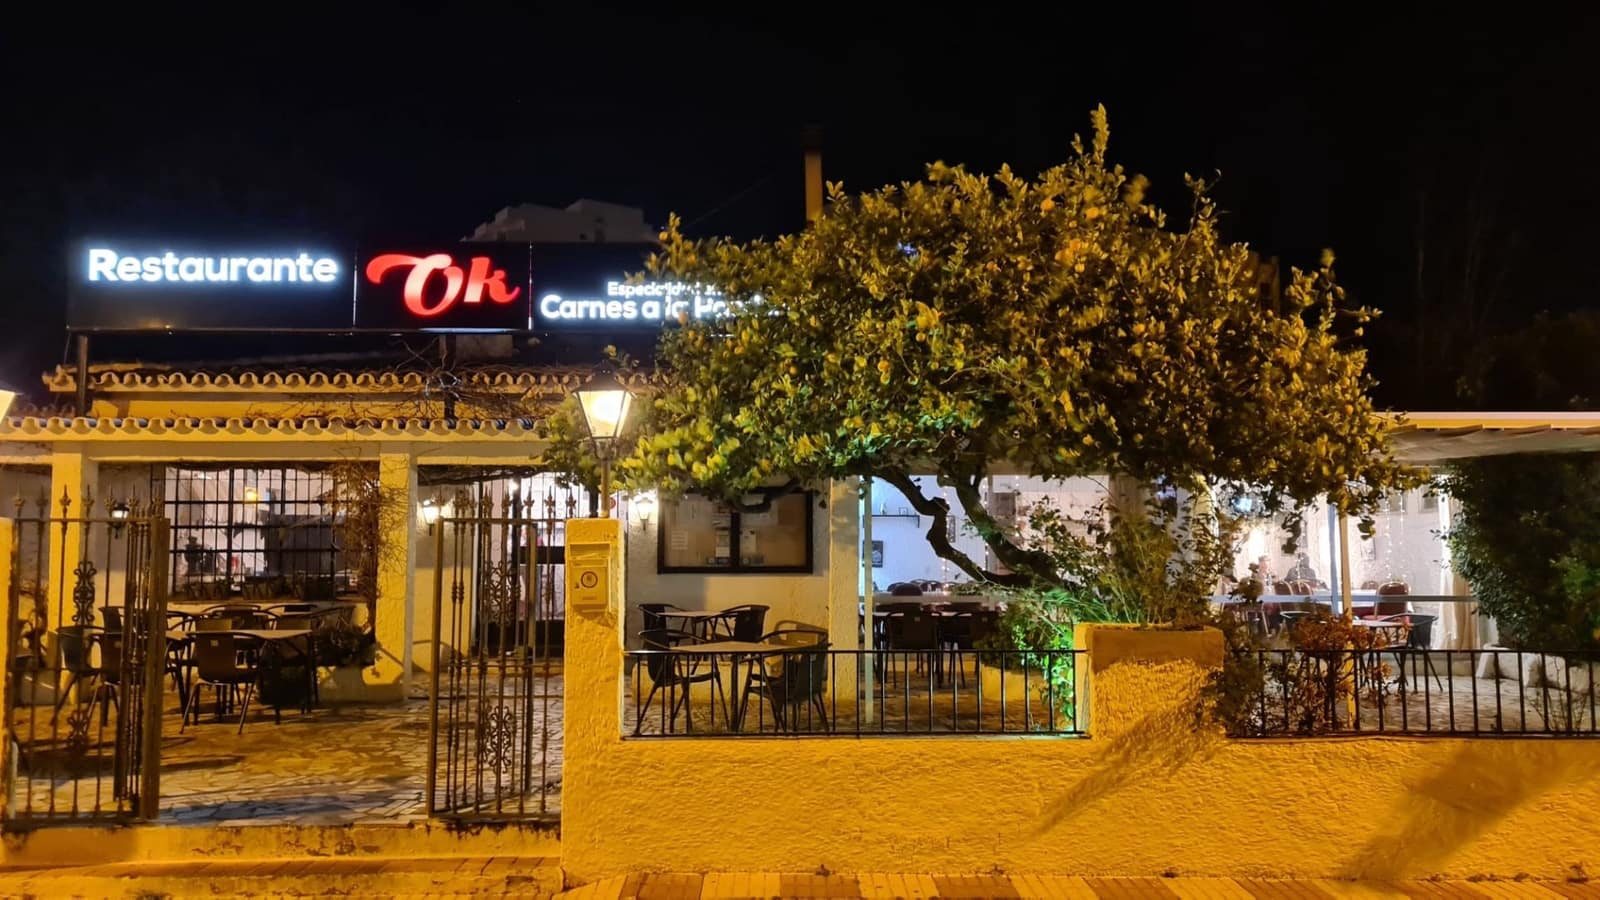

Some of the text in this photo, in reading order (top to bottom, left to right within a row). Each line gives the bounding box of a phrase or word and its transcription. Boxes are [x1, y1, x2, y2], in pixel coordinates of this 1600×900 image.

[88, 248, 339, 282] Restaurante
[540, 294, 637, 319] Carnes
[642, 300, 660, 319] a
